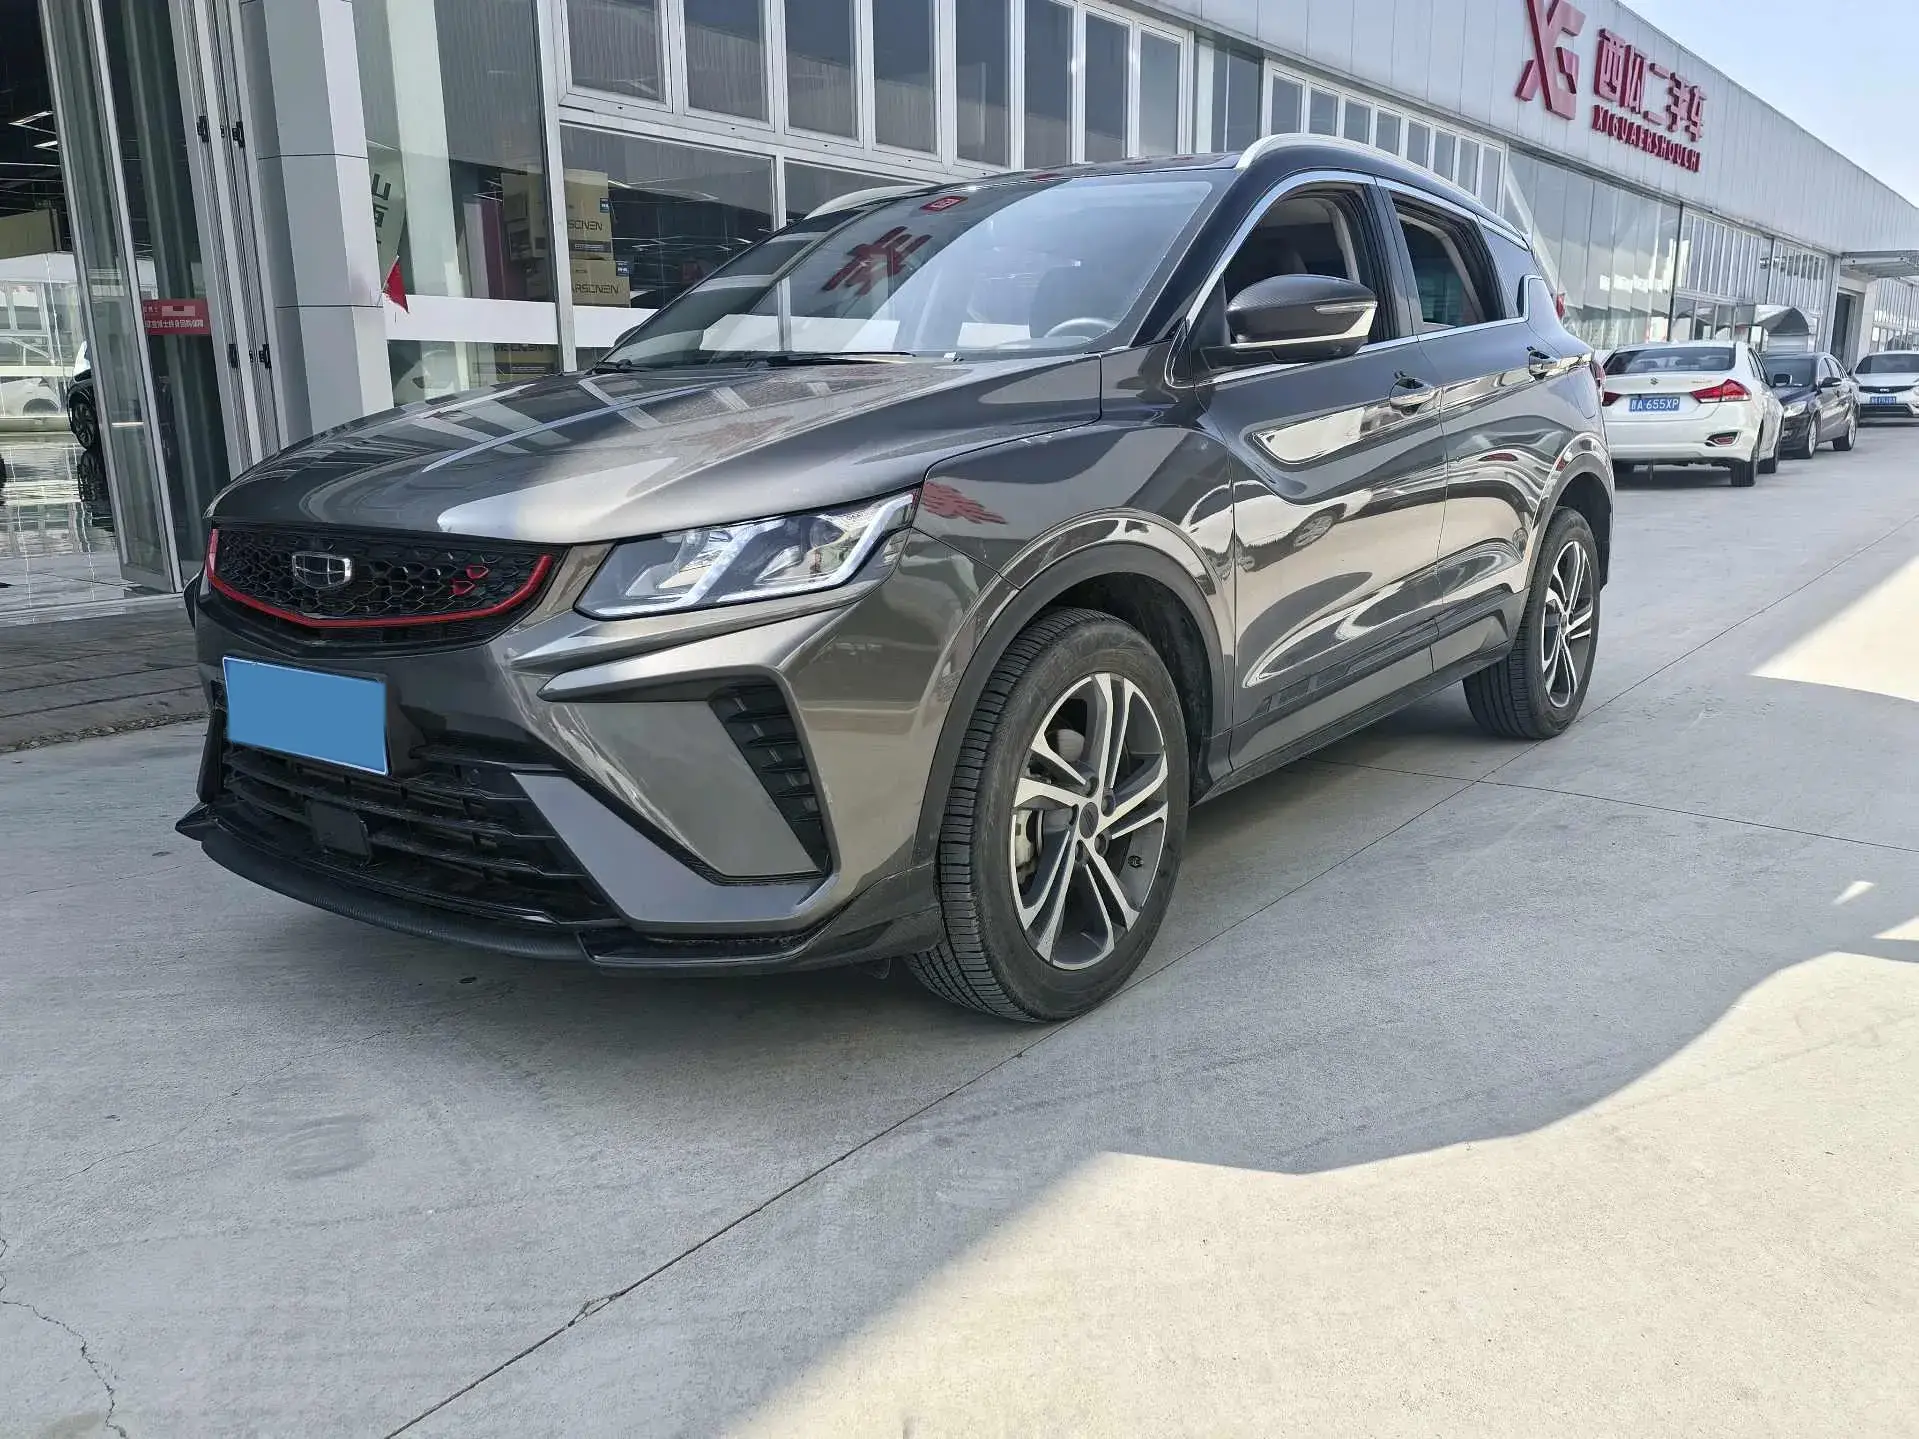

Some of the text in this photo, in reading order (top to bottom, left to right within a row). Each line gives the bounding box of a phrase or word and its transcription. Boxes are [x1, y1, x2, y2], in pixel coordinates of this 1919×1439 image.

[1593, 28, 1706, 142] 西瓜二手车
